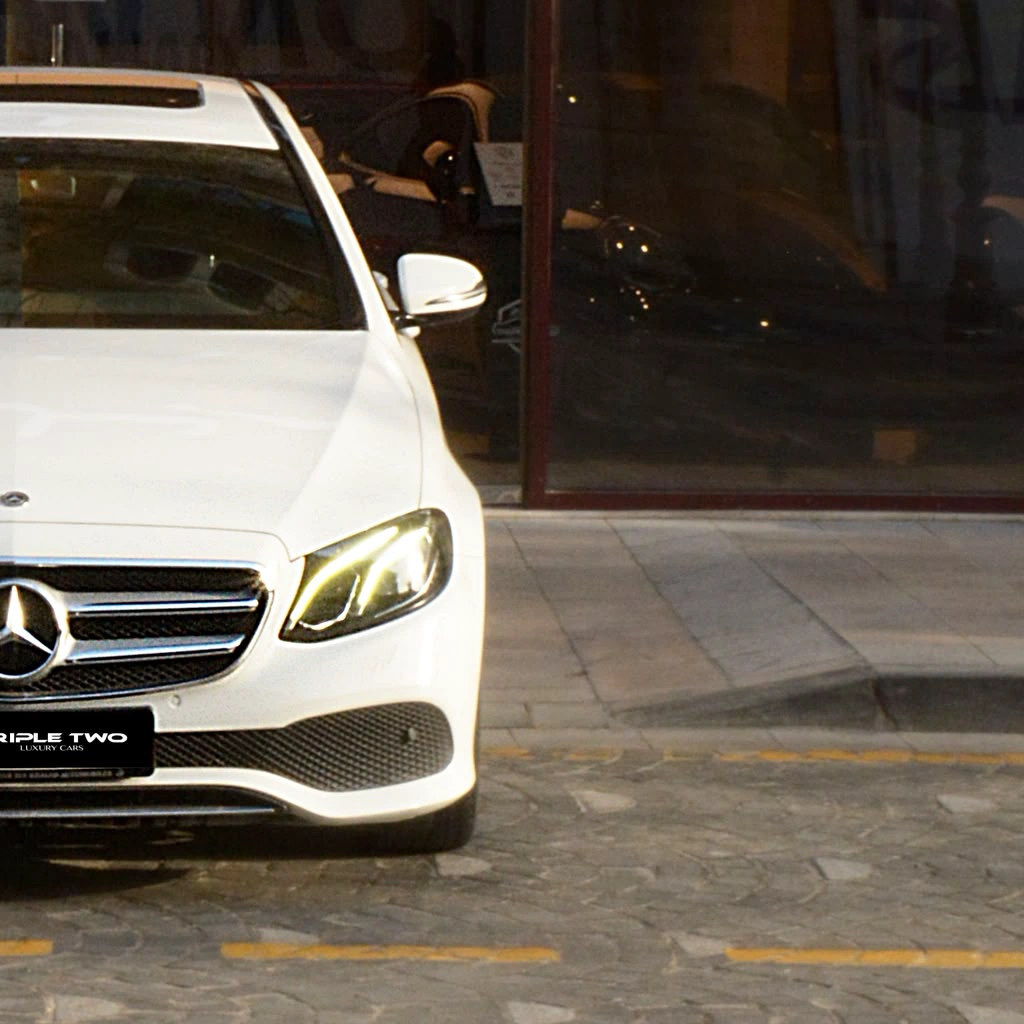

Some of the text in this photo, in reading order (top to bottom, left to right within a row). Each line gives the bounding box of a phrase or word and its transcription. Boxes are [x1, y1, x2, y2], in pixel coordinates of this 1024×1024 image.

[69, 732, 128, 743] TWO
[19, 744, 84, 752] LUXURY CARS
